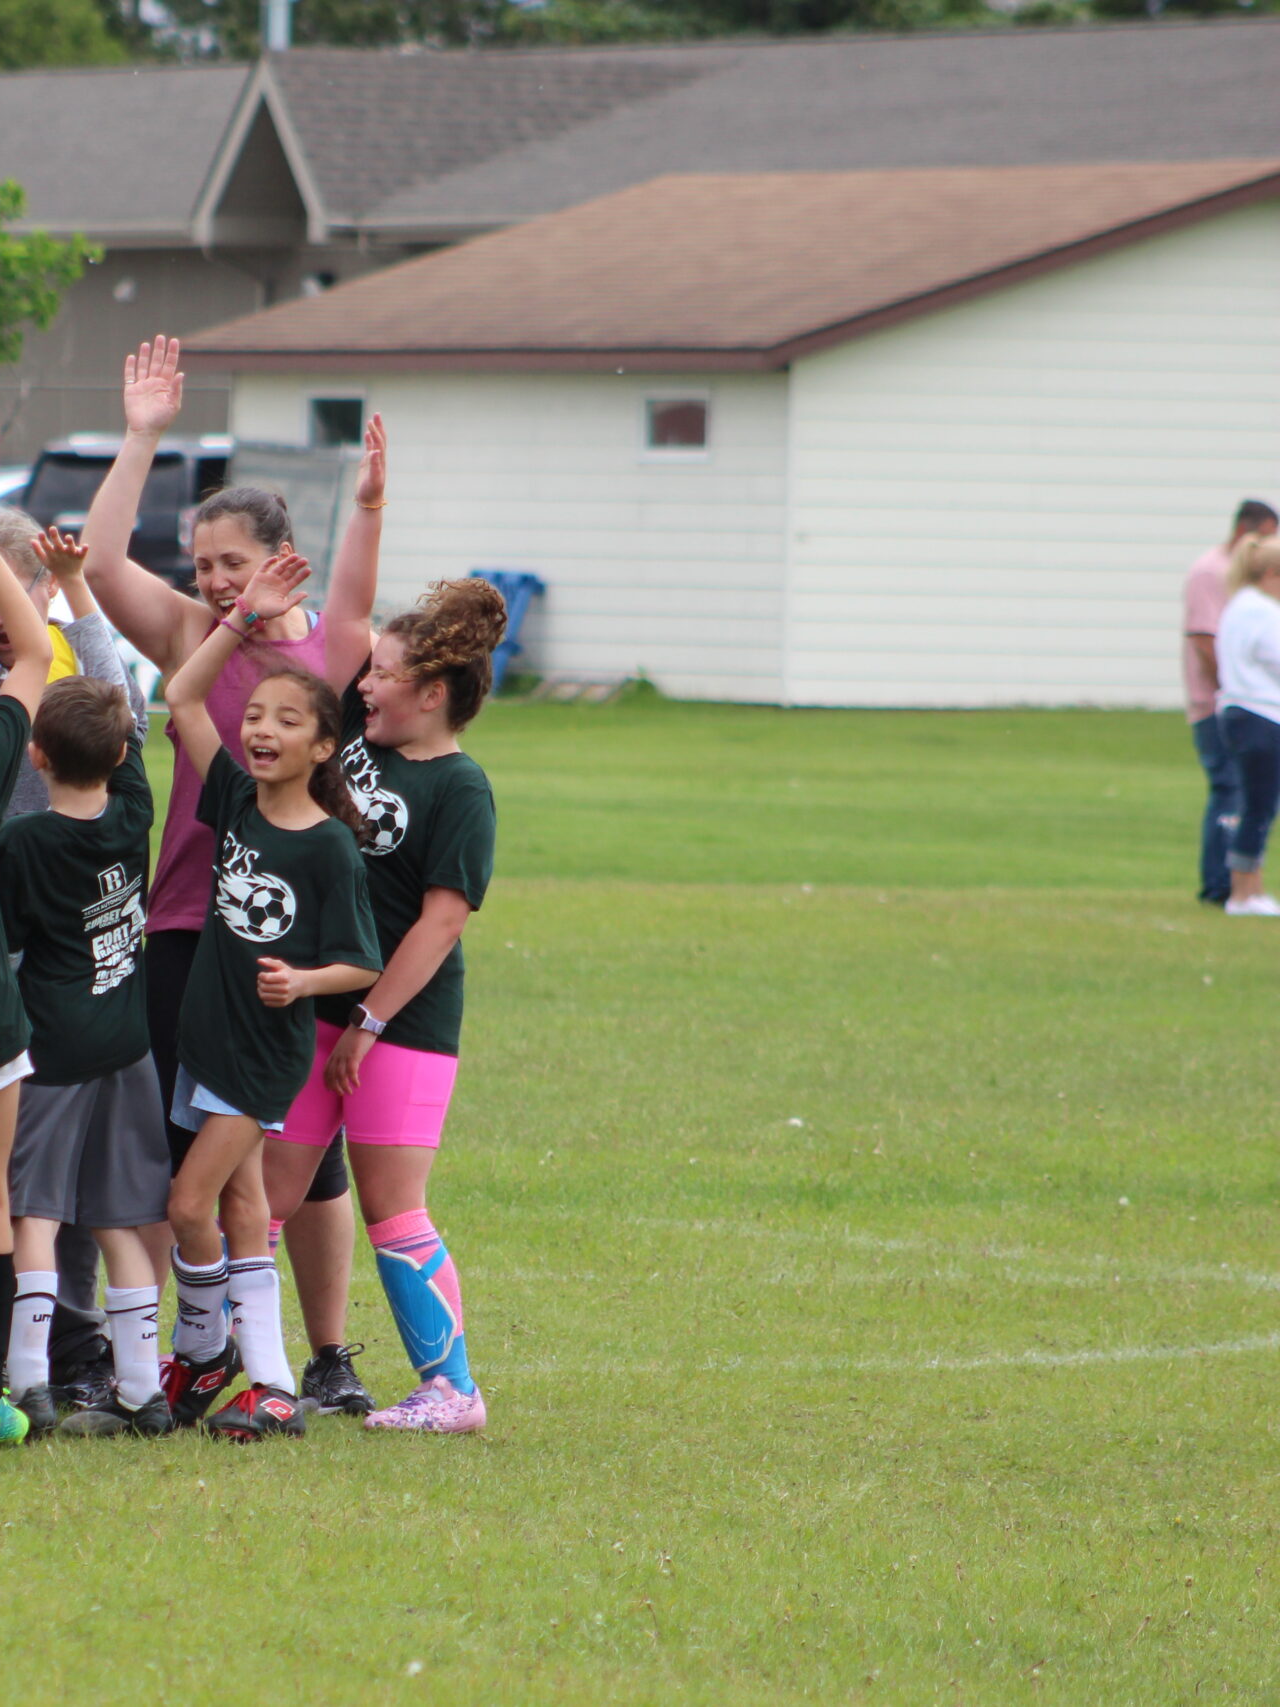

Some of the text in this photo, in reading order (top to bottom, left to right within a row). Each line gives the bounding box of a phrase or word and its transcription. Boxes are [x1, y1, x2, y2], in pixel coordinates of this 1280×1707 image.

[104, 870, 122, 893] B
[84, 908, 121, 931] SUNSET
[92, 922, 130, 961] FORT
